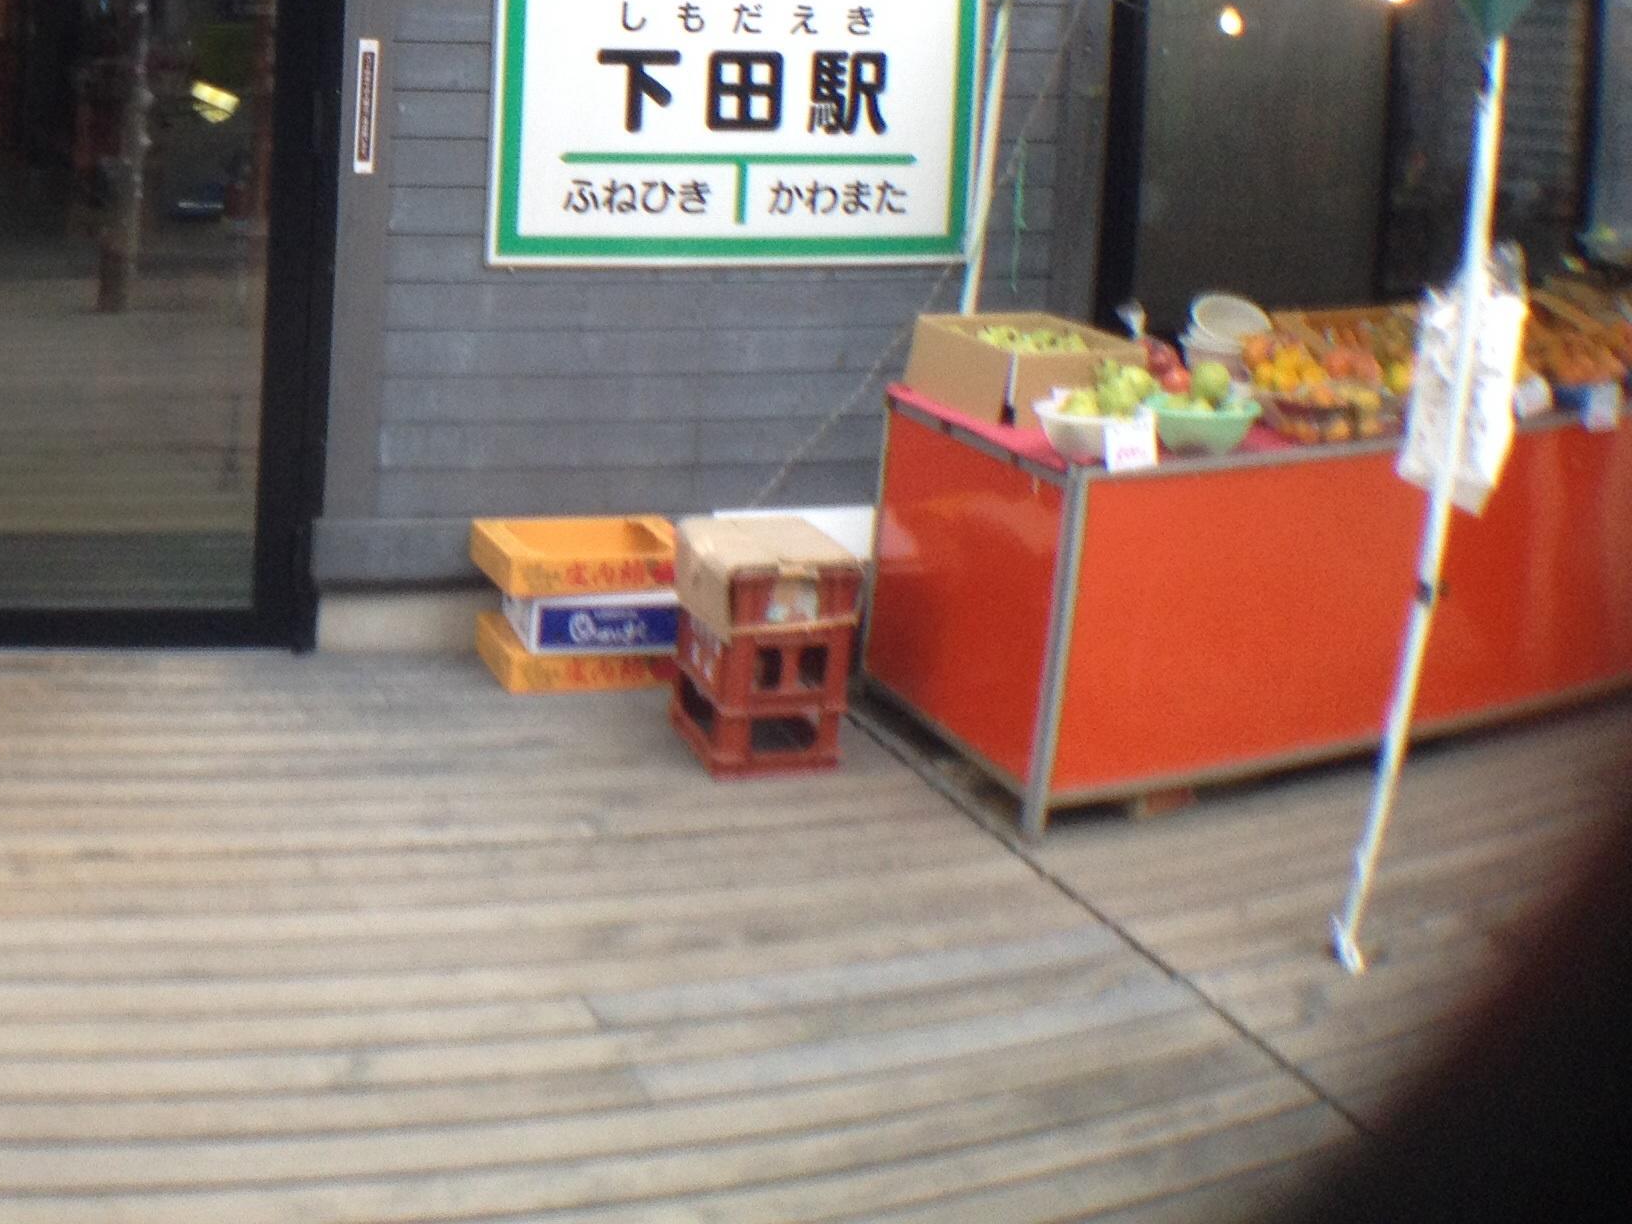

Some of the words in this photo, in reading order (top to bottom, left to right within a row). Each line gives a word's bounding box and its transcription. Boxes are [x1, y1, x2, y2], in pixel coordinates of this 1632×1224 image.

[619, 1, 875, 36] しもだえき
[596, 47, 889, 137] 下田駅
[562, 180, 711, 215] ふねひき
[767, 179, 908, 216] かわまた
